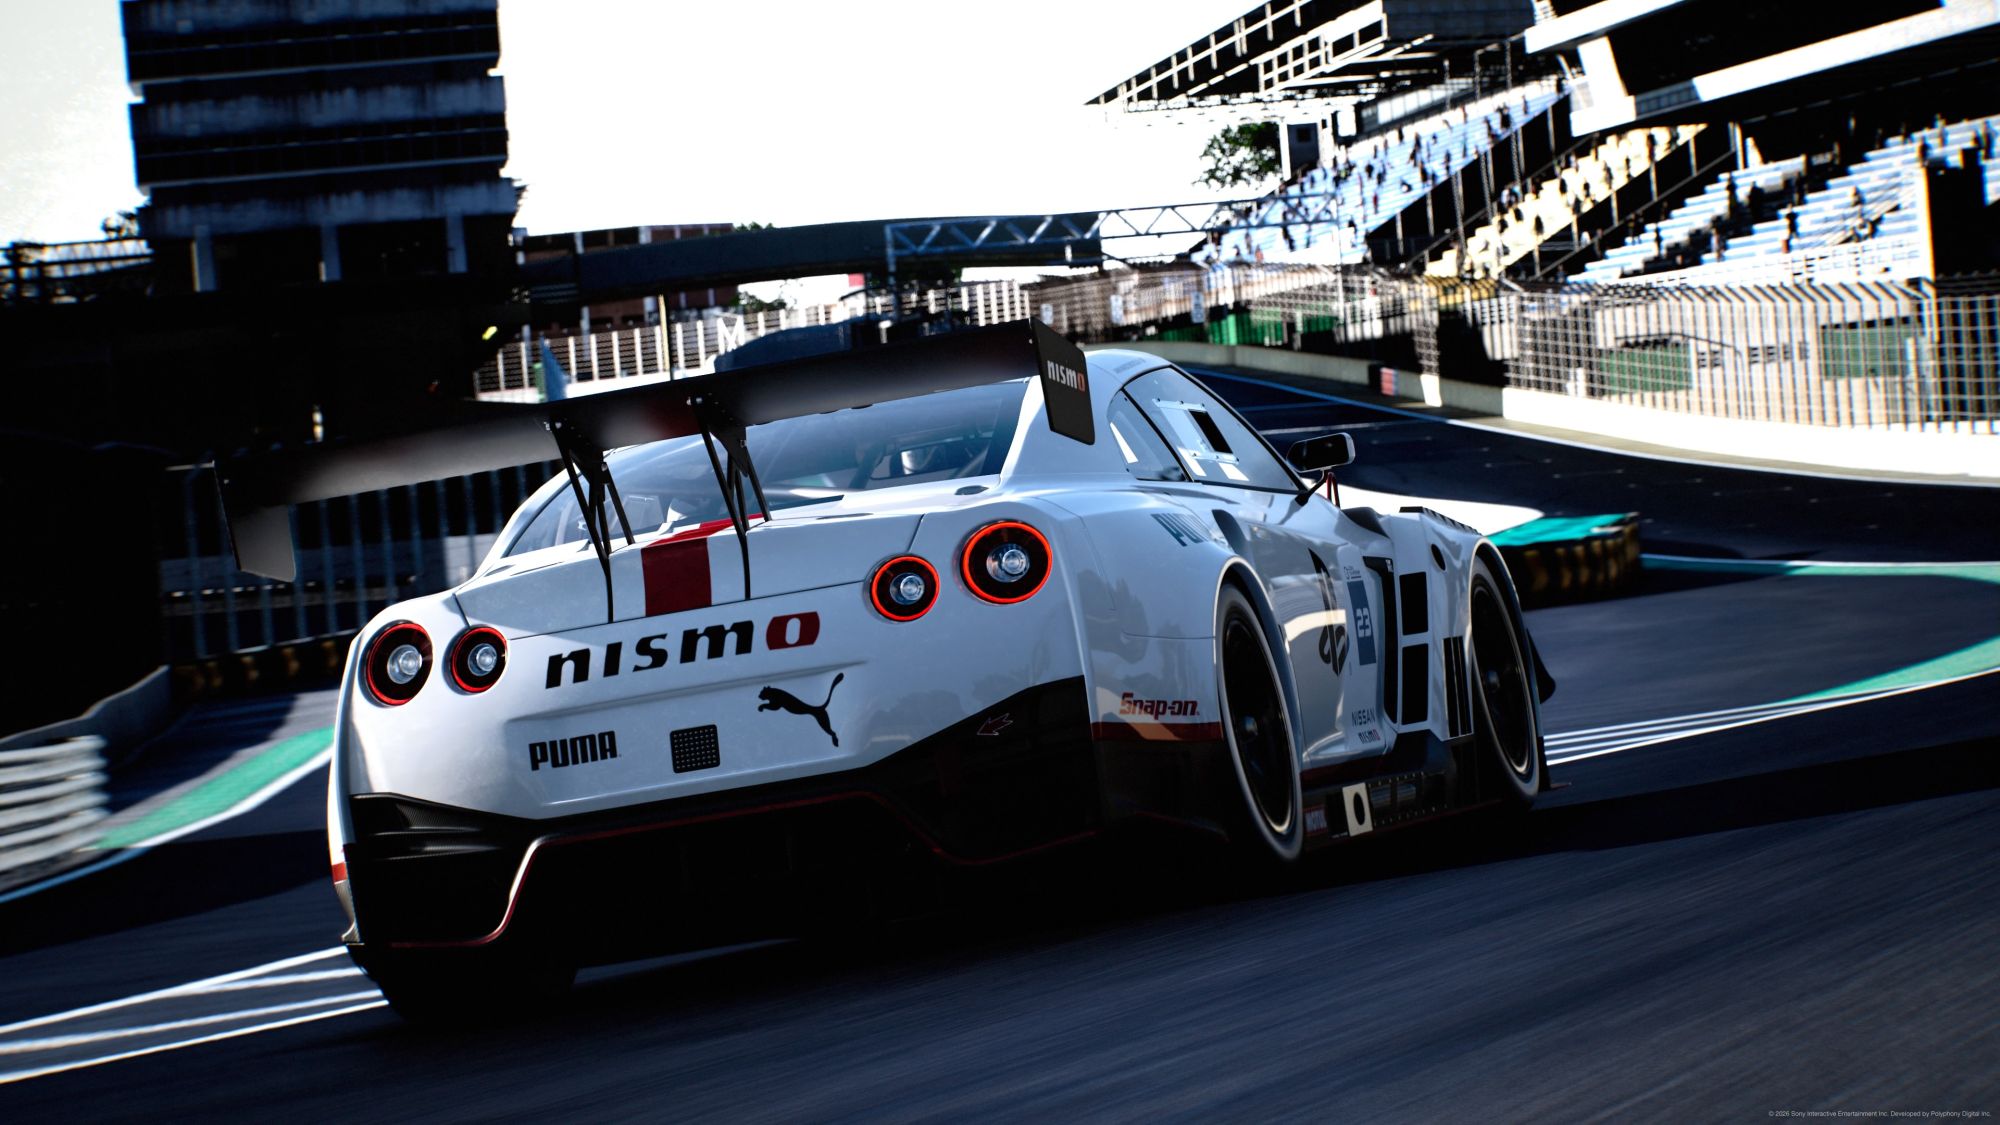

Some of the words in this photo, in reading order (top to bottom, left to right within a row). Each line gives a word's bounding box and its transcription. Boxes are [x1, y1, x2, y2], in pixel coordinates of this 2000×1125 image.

[1047, 360, 1086, 392] nismo
[1355, 607, 1372, 638] 23
[545, 611, 821, 690] nismo
[1119, 692, 1198, 721] Snap-on
[1351, 707, 1376, 728] NISSAN
[528, 730, 618, 771] PUMA
